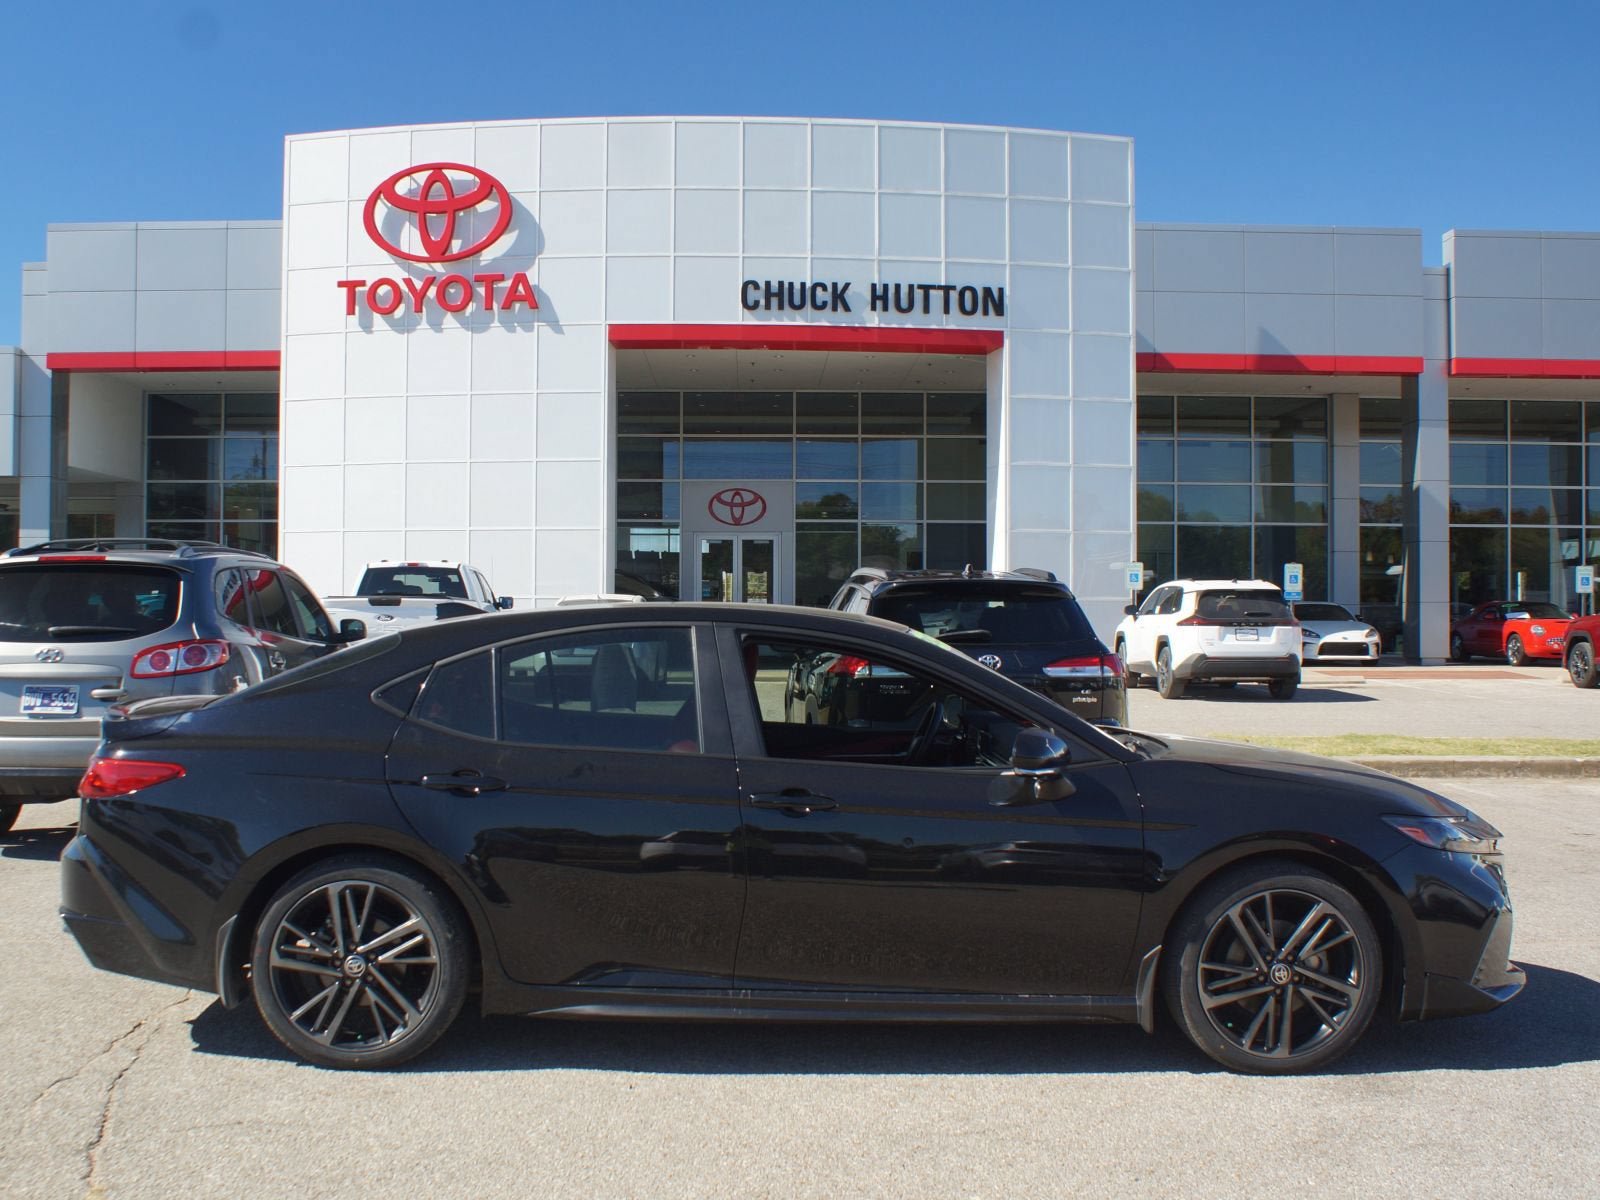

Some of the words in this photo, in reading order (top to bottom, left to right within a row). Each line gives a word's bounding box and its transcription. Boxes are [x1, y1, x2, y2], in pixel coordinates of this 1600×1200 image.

[337, 272, 539, 316] TOYOTA
[741, 280, 852, 313] CHUCK
[870, 283, 1005, 317] HUTTON
[51, 693, 76, 706] 5636
